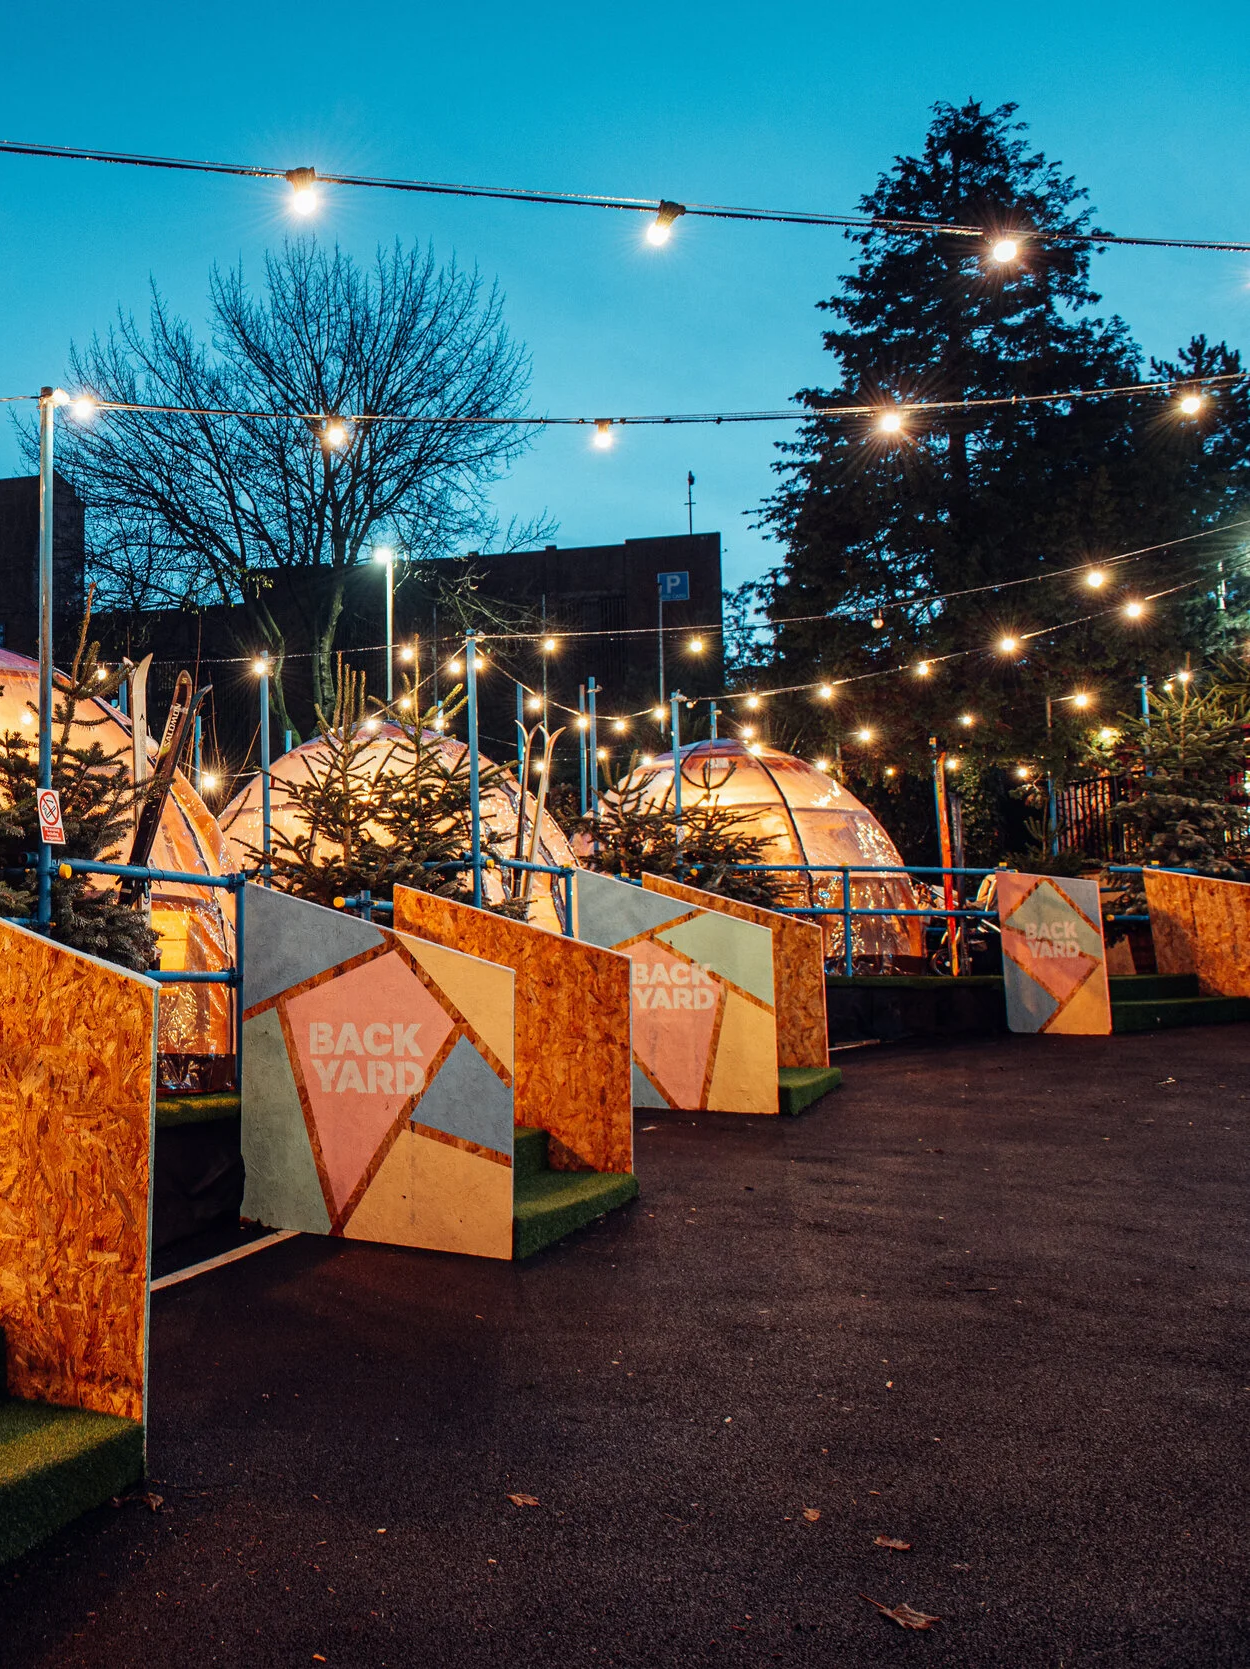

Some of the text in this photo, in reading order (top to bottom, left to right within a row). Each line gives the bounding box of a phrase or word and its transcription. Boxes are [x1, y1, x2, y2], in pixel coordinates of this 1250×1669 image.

[667, 575, 681, 593] P
[164, 702, 182, 748] SALOMON
[1024, 921, 1079, 940] BACK
[1026, 940, 1080, 958] YARD
[631, 962, 714, 986] BACK
[632, 987, 715, 1010] YARD
[309, 1022, 424, 1057] BACK
[310, 1059, 426, 1096] YARD
